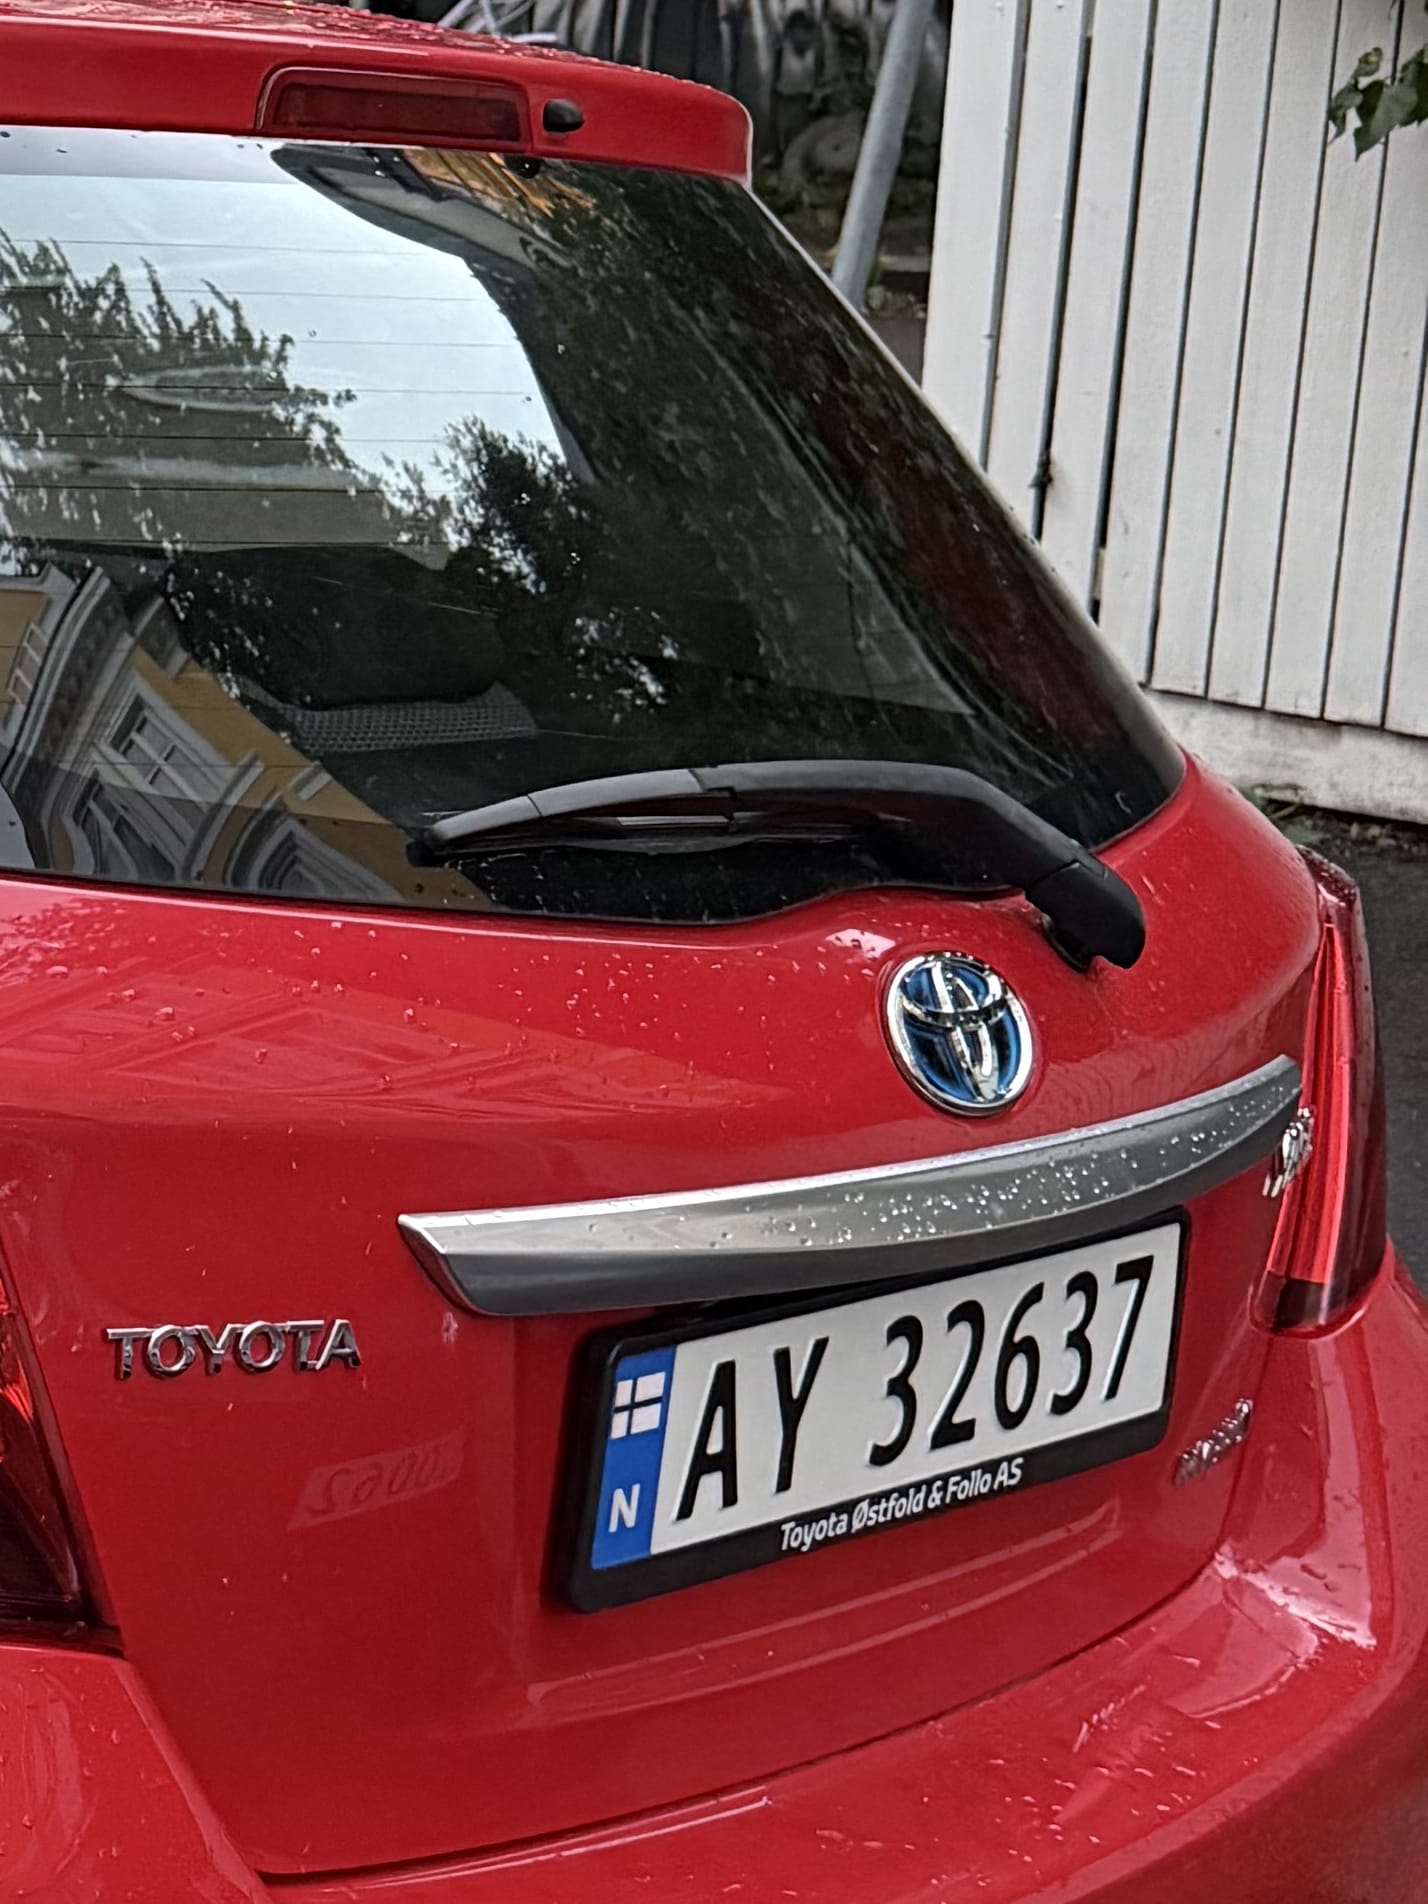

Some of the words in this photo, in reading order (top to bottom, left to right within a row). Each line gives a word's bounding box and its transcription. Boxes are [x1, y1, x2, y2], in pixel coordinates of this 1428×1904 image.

[105, 1318, 363, 1380] TOYOTA
[673, 1334, 830, 1522] AY
[865, 1253, 1155, 1467] 32637
[607, 1482, 642, 1534] N
[781, 1514, 848, 1551] Toyota
[851, 1489, 924, 1533] Østfold
[926, 1480, 945, 1509] &
[945, 1467, 992, 1505] Follo
[994, 1456, 1025, 1487] AS
